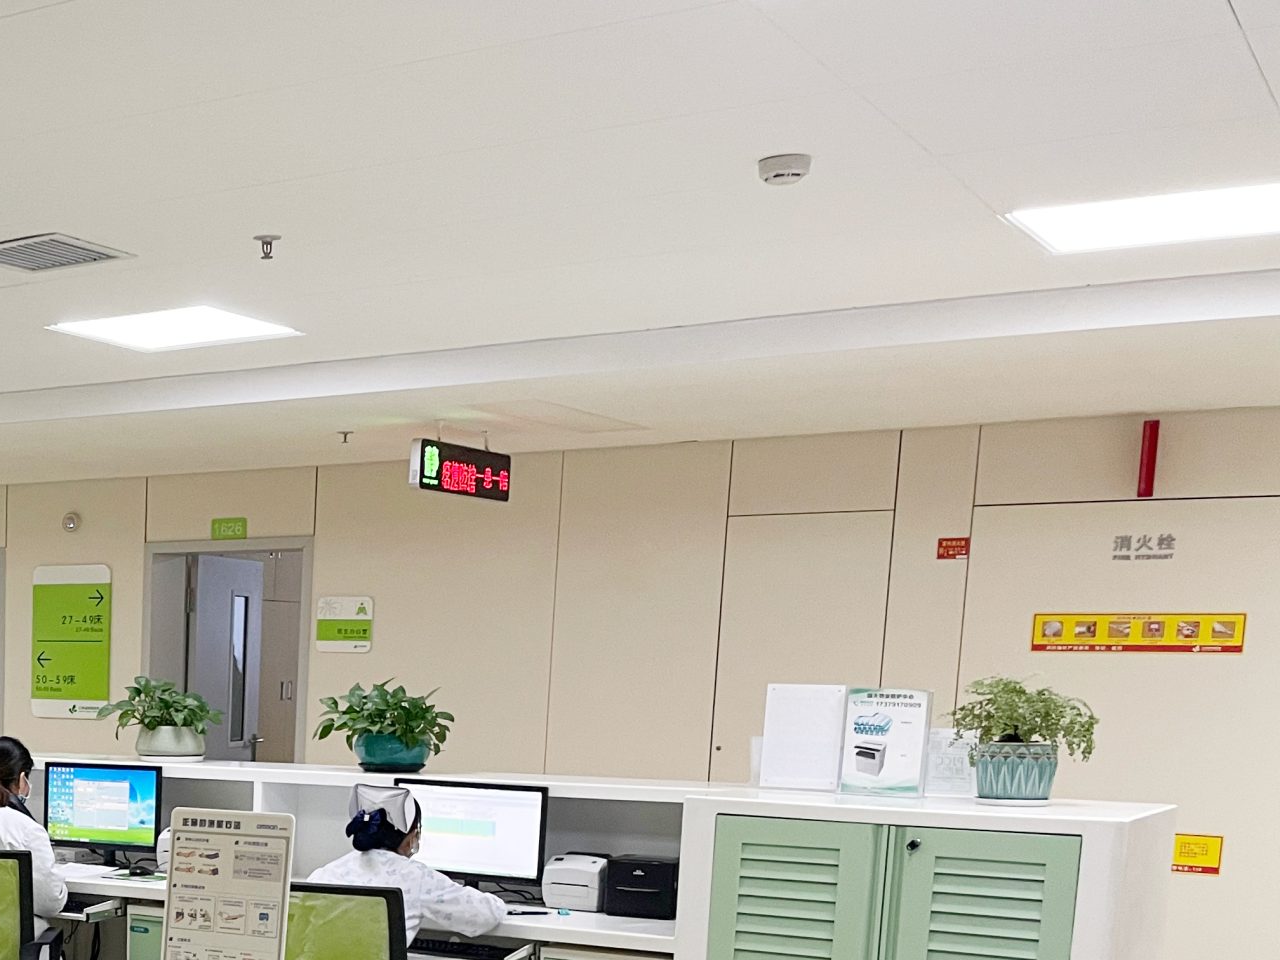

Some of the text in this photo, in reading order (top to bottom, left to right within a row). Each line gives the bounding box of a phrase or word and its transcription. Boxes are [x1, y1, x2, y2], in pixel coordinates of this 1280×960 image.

[214, 519, 243, 536] 1626
[1112, 533, 1176, 552] 消火栓
